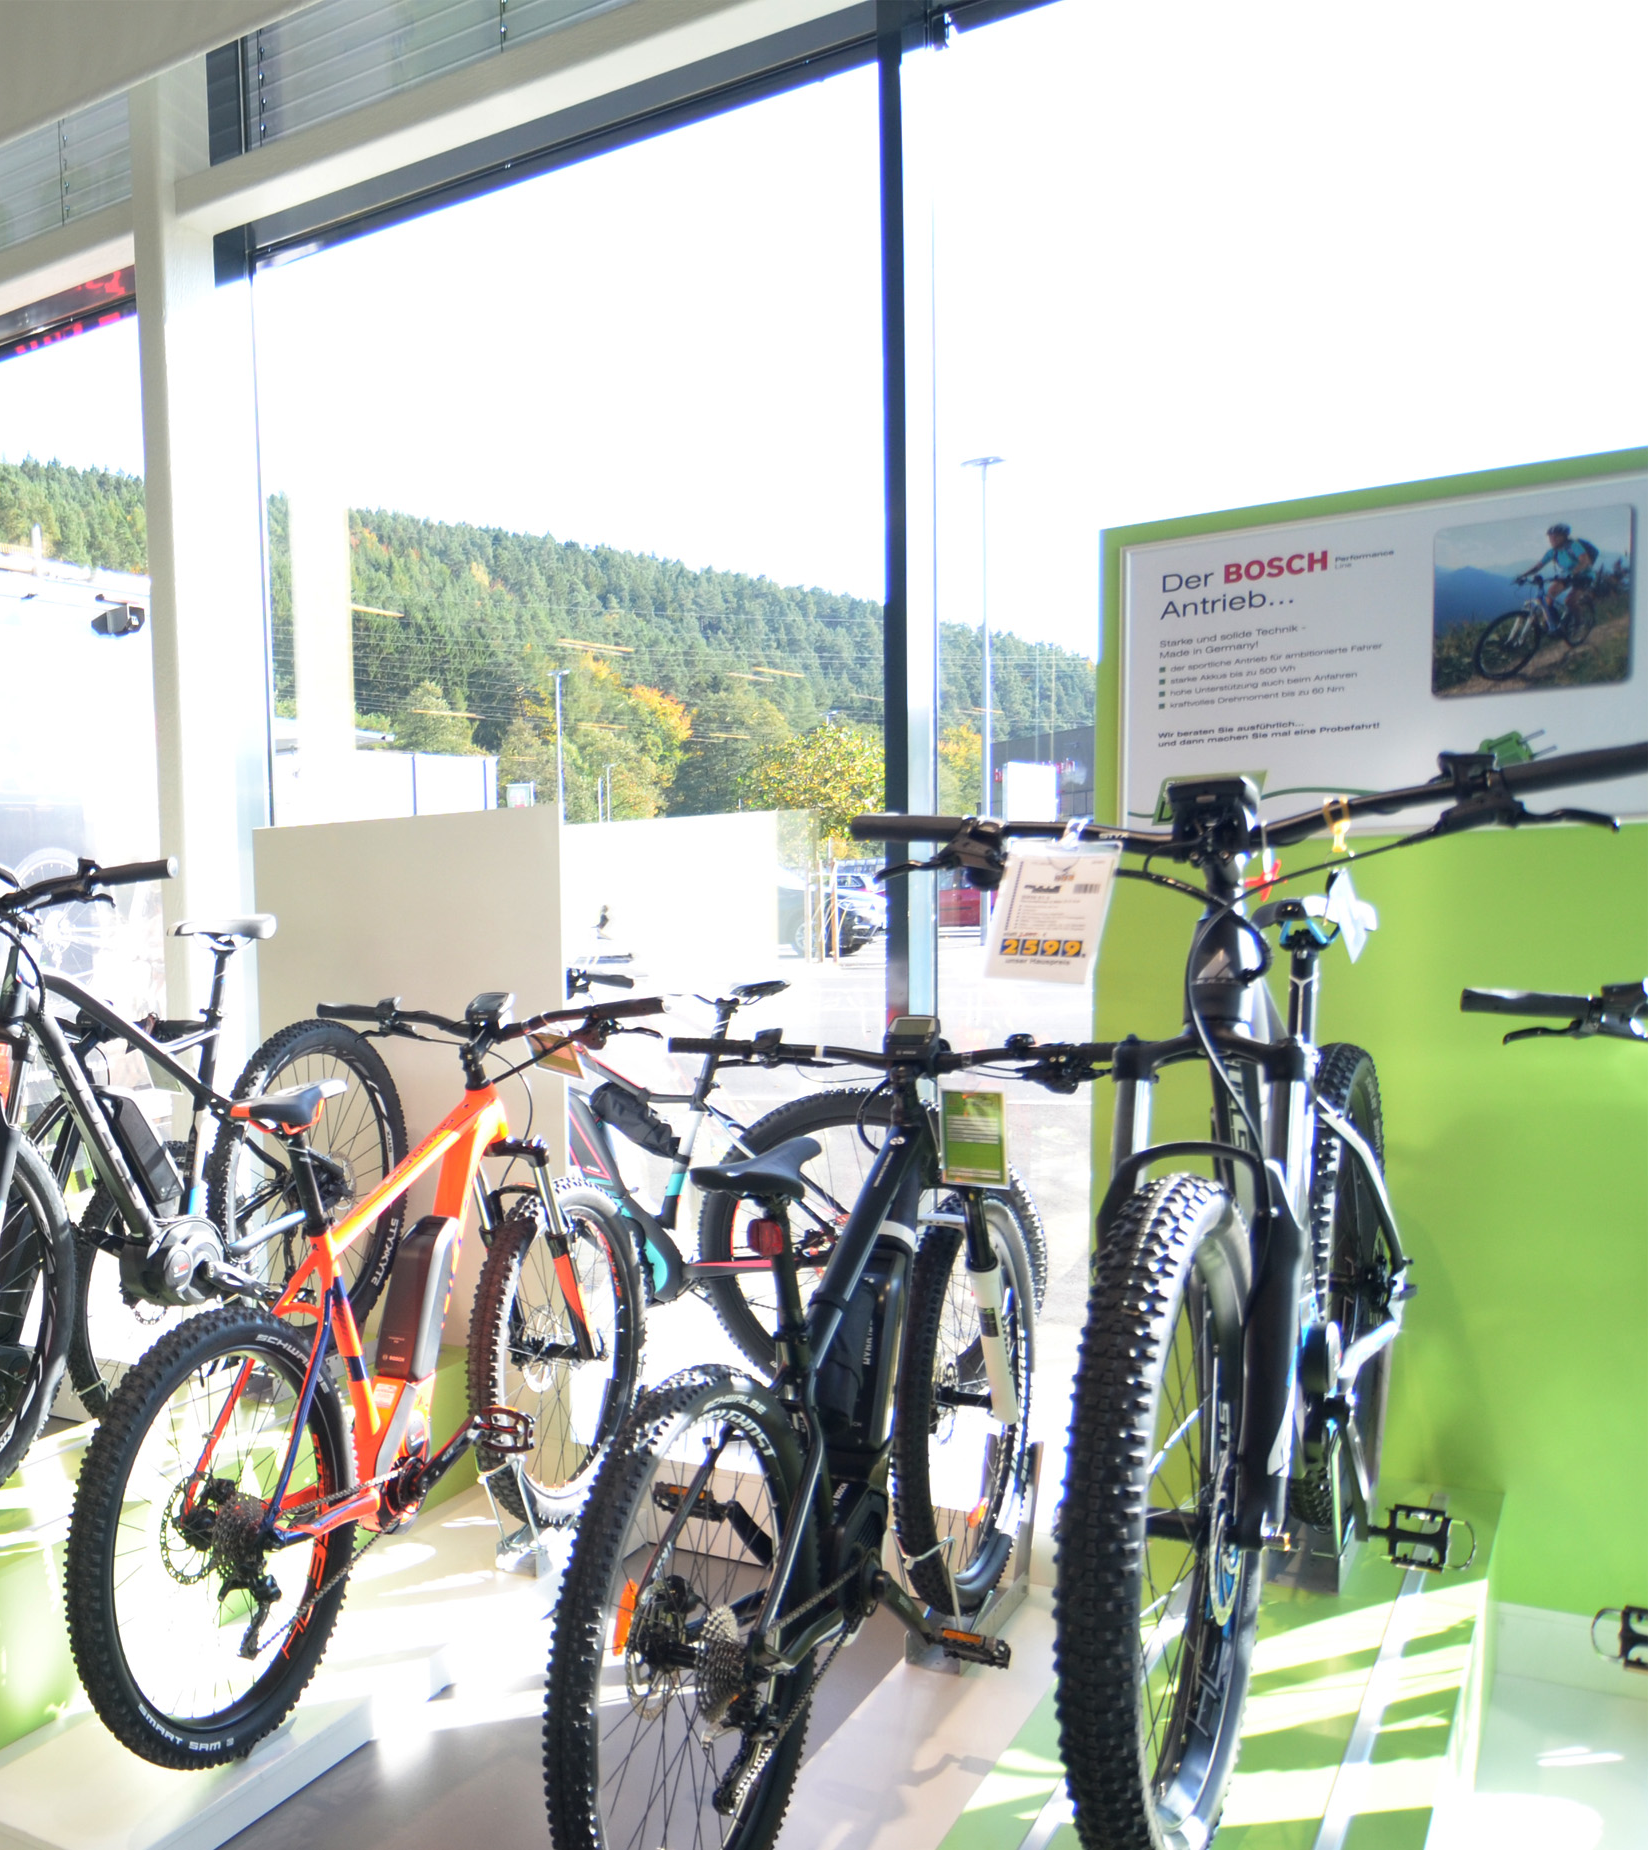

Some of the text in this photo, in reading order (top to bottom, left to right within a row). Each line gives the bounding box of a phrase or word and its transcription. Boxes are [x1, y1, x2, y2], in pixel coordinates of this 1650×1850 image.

[1162, 550, 1395, 593] Der BOSCH Performance
[1160, 590, 1294, 620] Antrieb...
[1160, 636, 1194, 648] Starke
[1196, 634, 1217, 644] und
[1220, 629, 1253, 641] solide
[1256, 624, 1299, 637] Technik
[1159, 640, 1259, 660] Made in Germany!
[1170, 642, 1384, 673] der sportliche Antrieb für ambitionierte Fahrer
[1170, 675, 1198, 685] starke
[1200, 672, 1228, 681] Akkus
[1230, 669, 1244, 678] bis
[1259, 666, 1278, 674] 500
[1279, 664, 1297, 673] Wh
[1170, 671, 1358, 697] hohe Unterstützung auch beim Anfahren
[1170, 698, 1216, 709] kraftvolles
[1218, 692, 1280, 705] Drehmoment
[1281, 689, 1296, 698] bis
[1327, 685, 1345, 694] Nm
[1158, 731, 1175, 739] Wir
[1176, 727, 1216, 739] beraten
[1218, 724, 1235, 734] Sie
[1158, 721, 1381, 748] und dann machen Sie mal eine Probefahrt!
[371, 1218, 399, 1287] STYXKYTE
[138, 1703, 183, 1745] SMART
[188, 1740, 222, 1752] SAM
